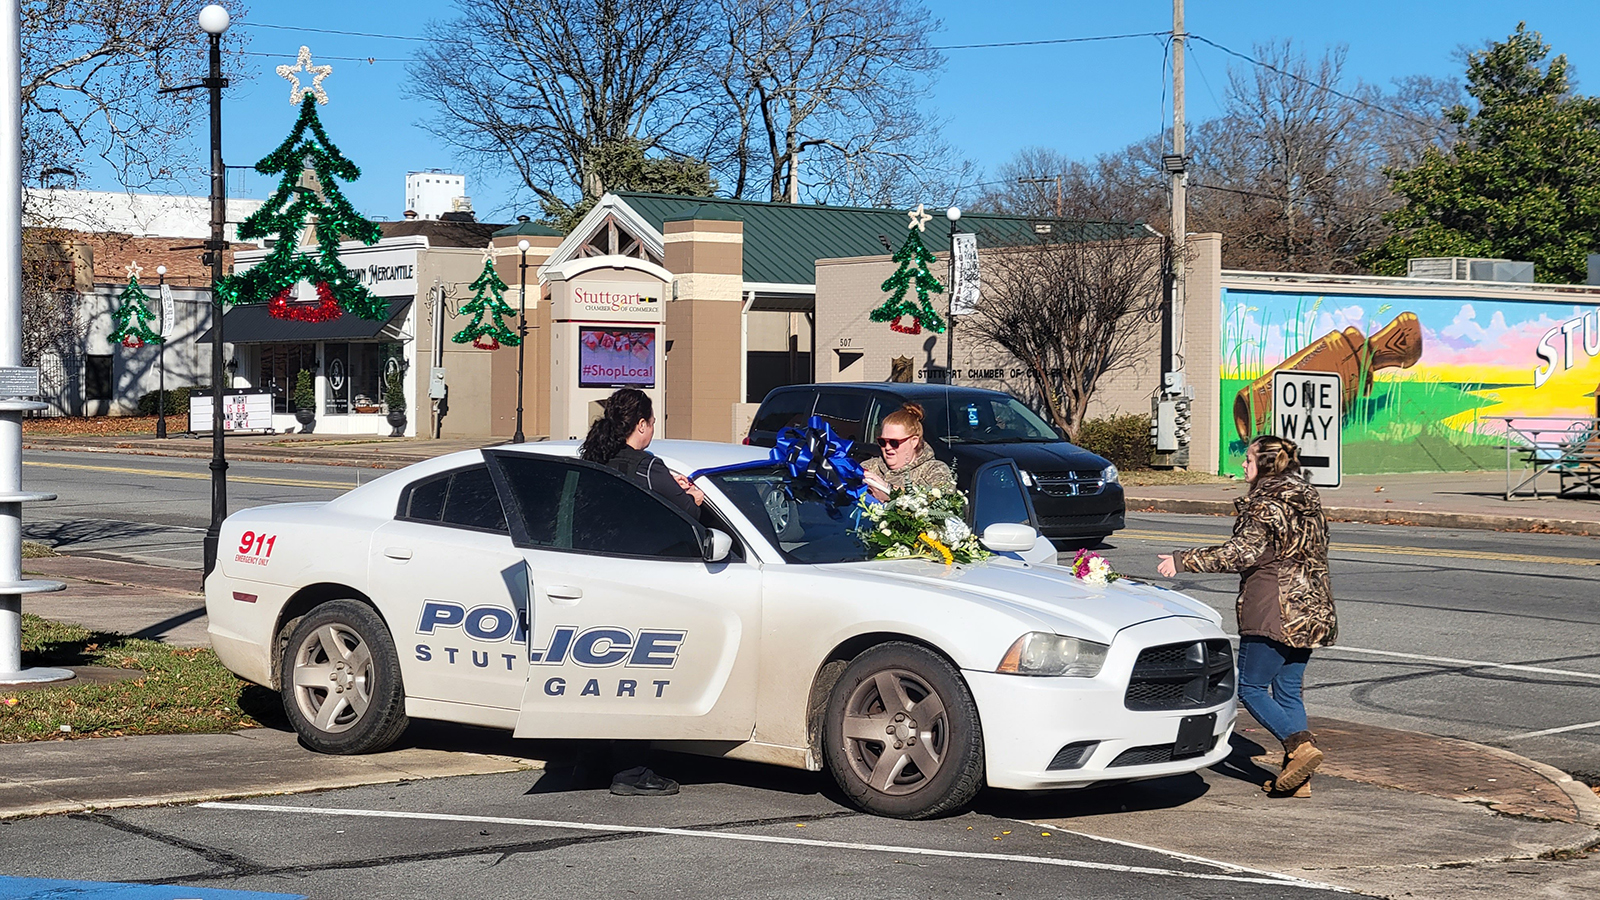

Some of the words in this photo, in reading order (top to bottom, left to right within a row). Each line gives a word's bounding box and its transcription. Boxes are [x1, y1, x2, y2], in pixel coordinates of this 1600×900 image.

[368, 264, 413, 285] MERCANTILE
[574, 287, 641, 312] Stuttgart
[840, 338, 852, 347] 507
[582, 364, 653, 379] #ShopLocal
[917, 369, 962, 379] STUTTGRT
[968, 368, 1005, 379] CHAMBER
[1010, 368, 1021, 378] OF
[1283, 381, 1332, 409] ONE
[1281, 414, 1334, 441] WAY
[238, 530, 277, 558] 911
[235, 554, 258, 565] EMERGENCY
[258, 558, 269, 566] ONLY
